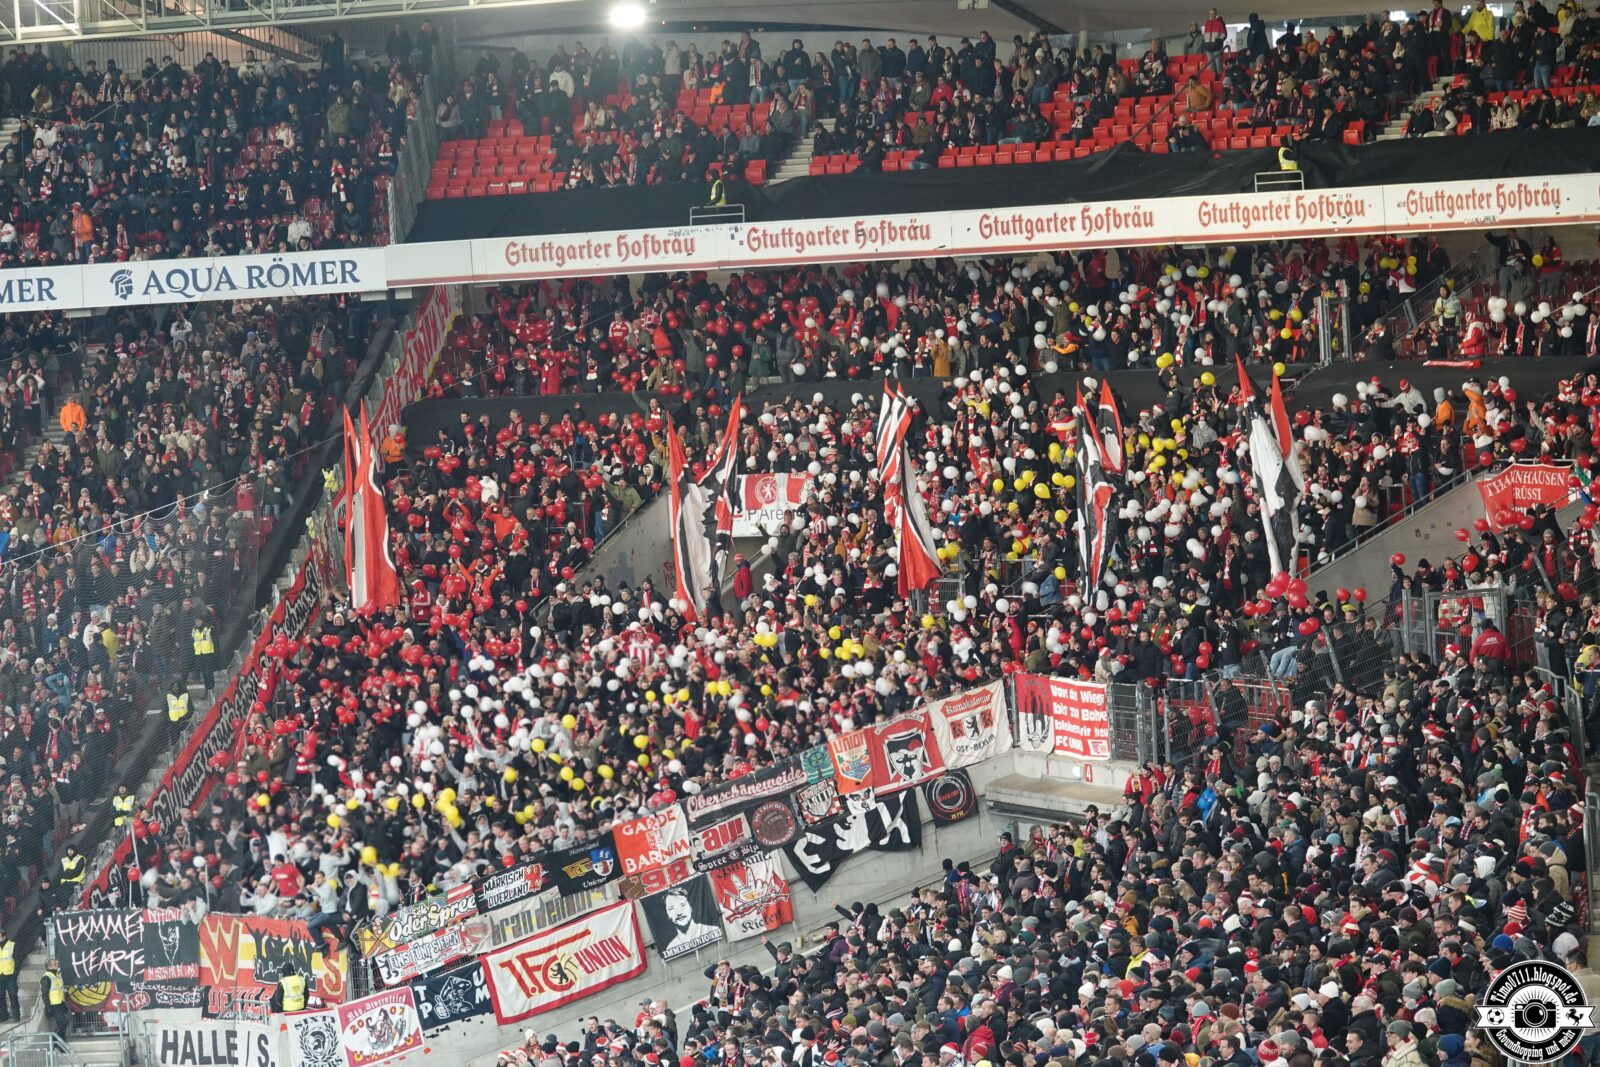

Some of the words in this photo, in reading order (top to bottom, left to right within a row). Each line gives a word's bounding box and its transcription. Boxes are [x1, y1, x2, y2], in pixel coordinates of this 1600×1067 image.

[1198, 200, 1291, 229] Stuttgarter
[1295, 192, 1366, 223] Hofbräu
[1406, 186, 1492, 218] Stuttgarter
[1496, 181, 1561, 214] Hofbräu
[746, 222, 850, 253] Stuttgarter
[855, 218, 931, 249] Hofbräu
[979, 209, 1077, 241] Stuttgarter
[1081, 205, 1154, 236] Hofbräu
[504, 234, 611, 268] Stuttgarter
[143, 265, 238, 299] AQUA
[246, 257, 361, 290] RÖMER
[687, 766, 806, 815] Oberschöneweide
[1086, 766, 1092, 781] 4
[482, 866, 525, 895] MÄRKISCH
[487, 882, 530, 909] ODERLAND
[389, 914, 428, 942] Oder
[427, 894, 478, 927] Spree
[574, 934, 632, 975] UNION
[662, 940, 690, 960] IMMER
[295, 1015, 336, 1031] SIXTY
[160, 1029, 239, 1066] HALLE
[257, 1033, 276, 1067] S.
